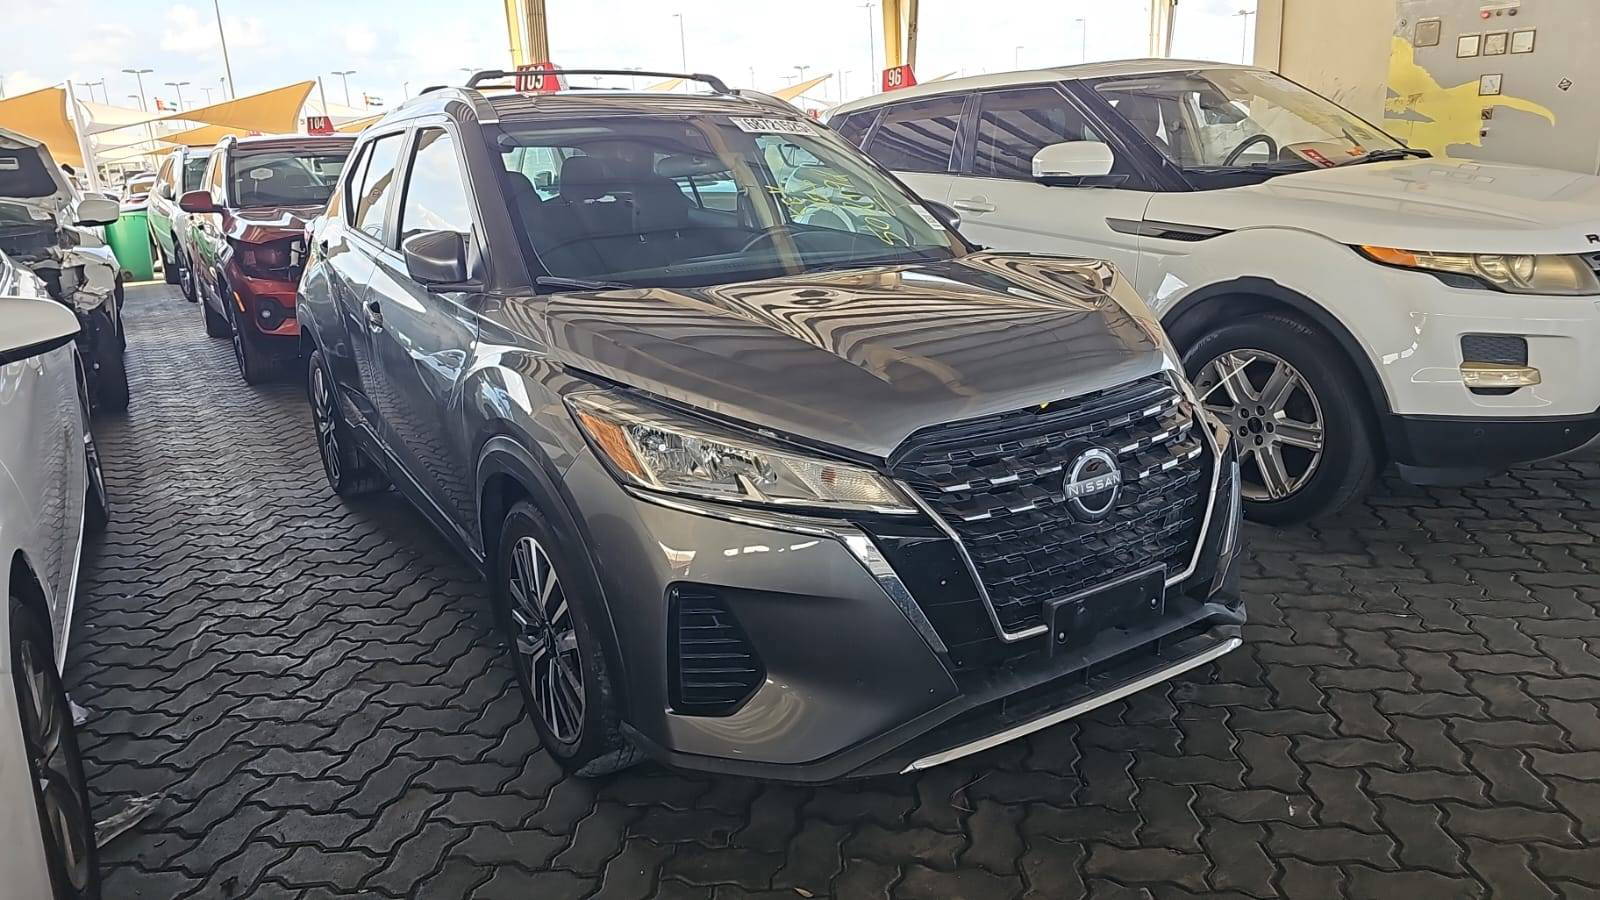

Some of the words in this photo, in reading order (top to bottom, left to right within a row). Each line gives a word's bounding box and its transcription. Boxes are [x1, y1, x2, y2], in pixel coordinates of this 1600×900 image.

[888, 68, 902, 87] 96
[310, 117, 325, 129] 104
[1068, 474, 1120, 496] NISSAN
